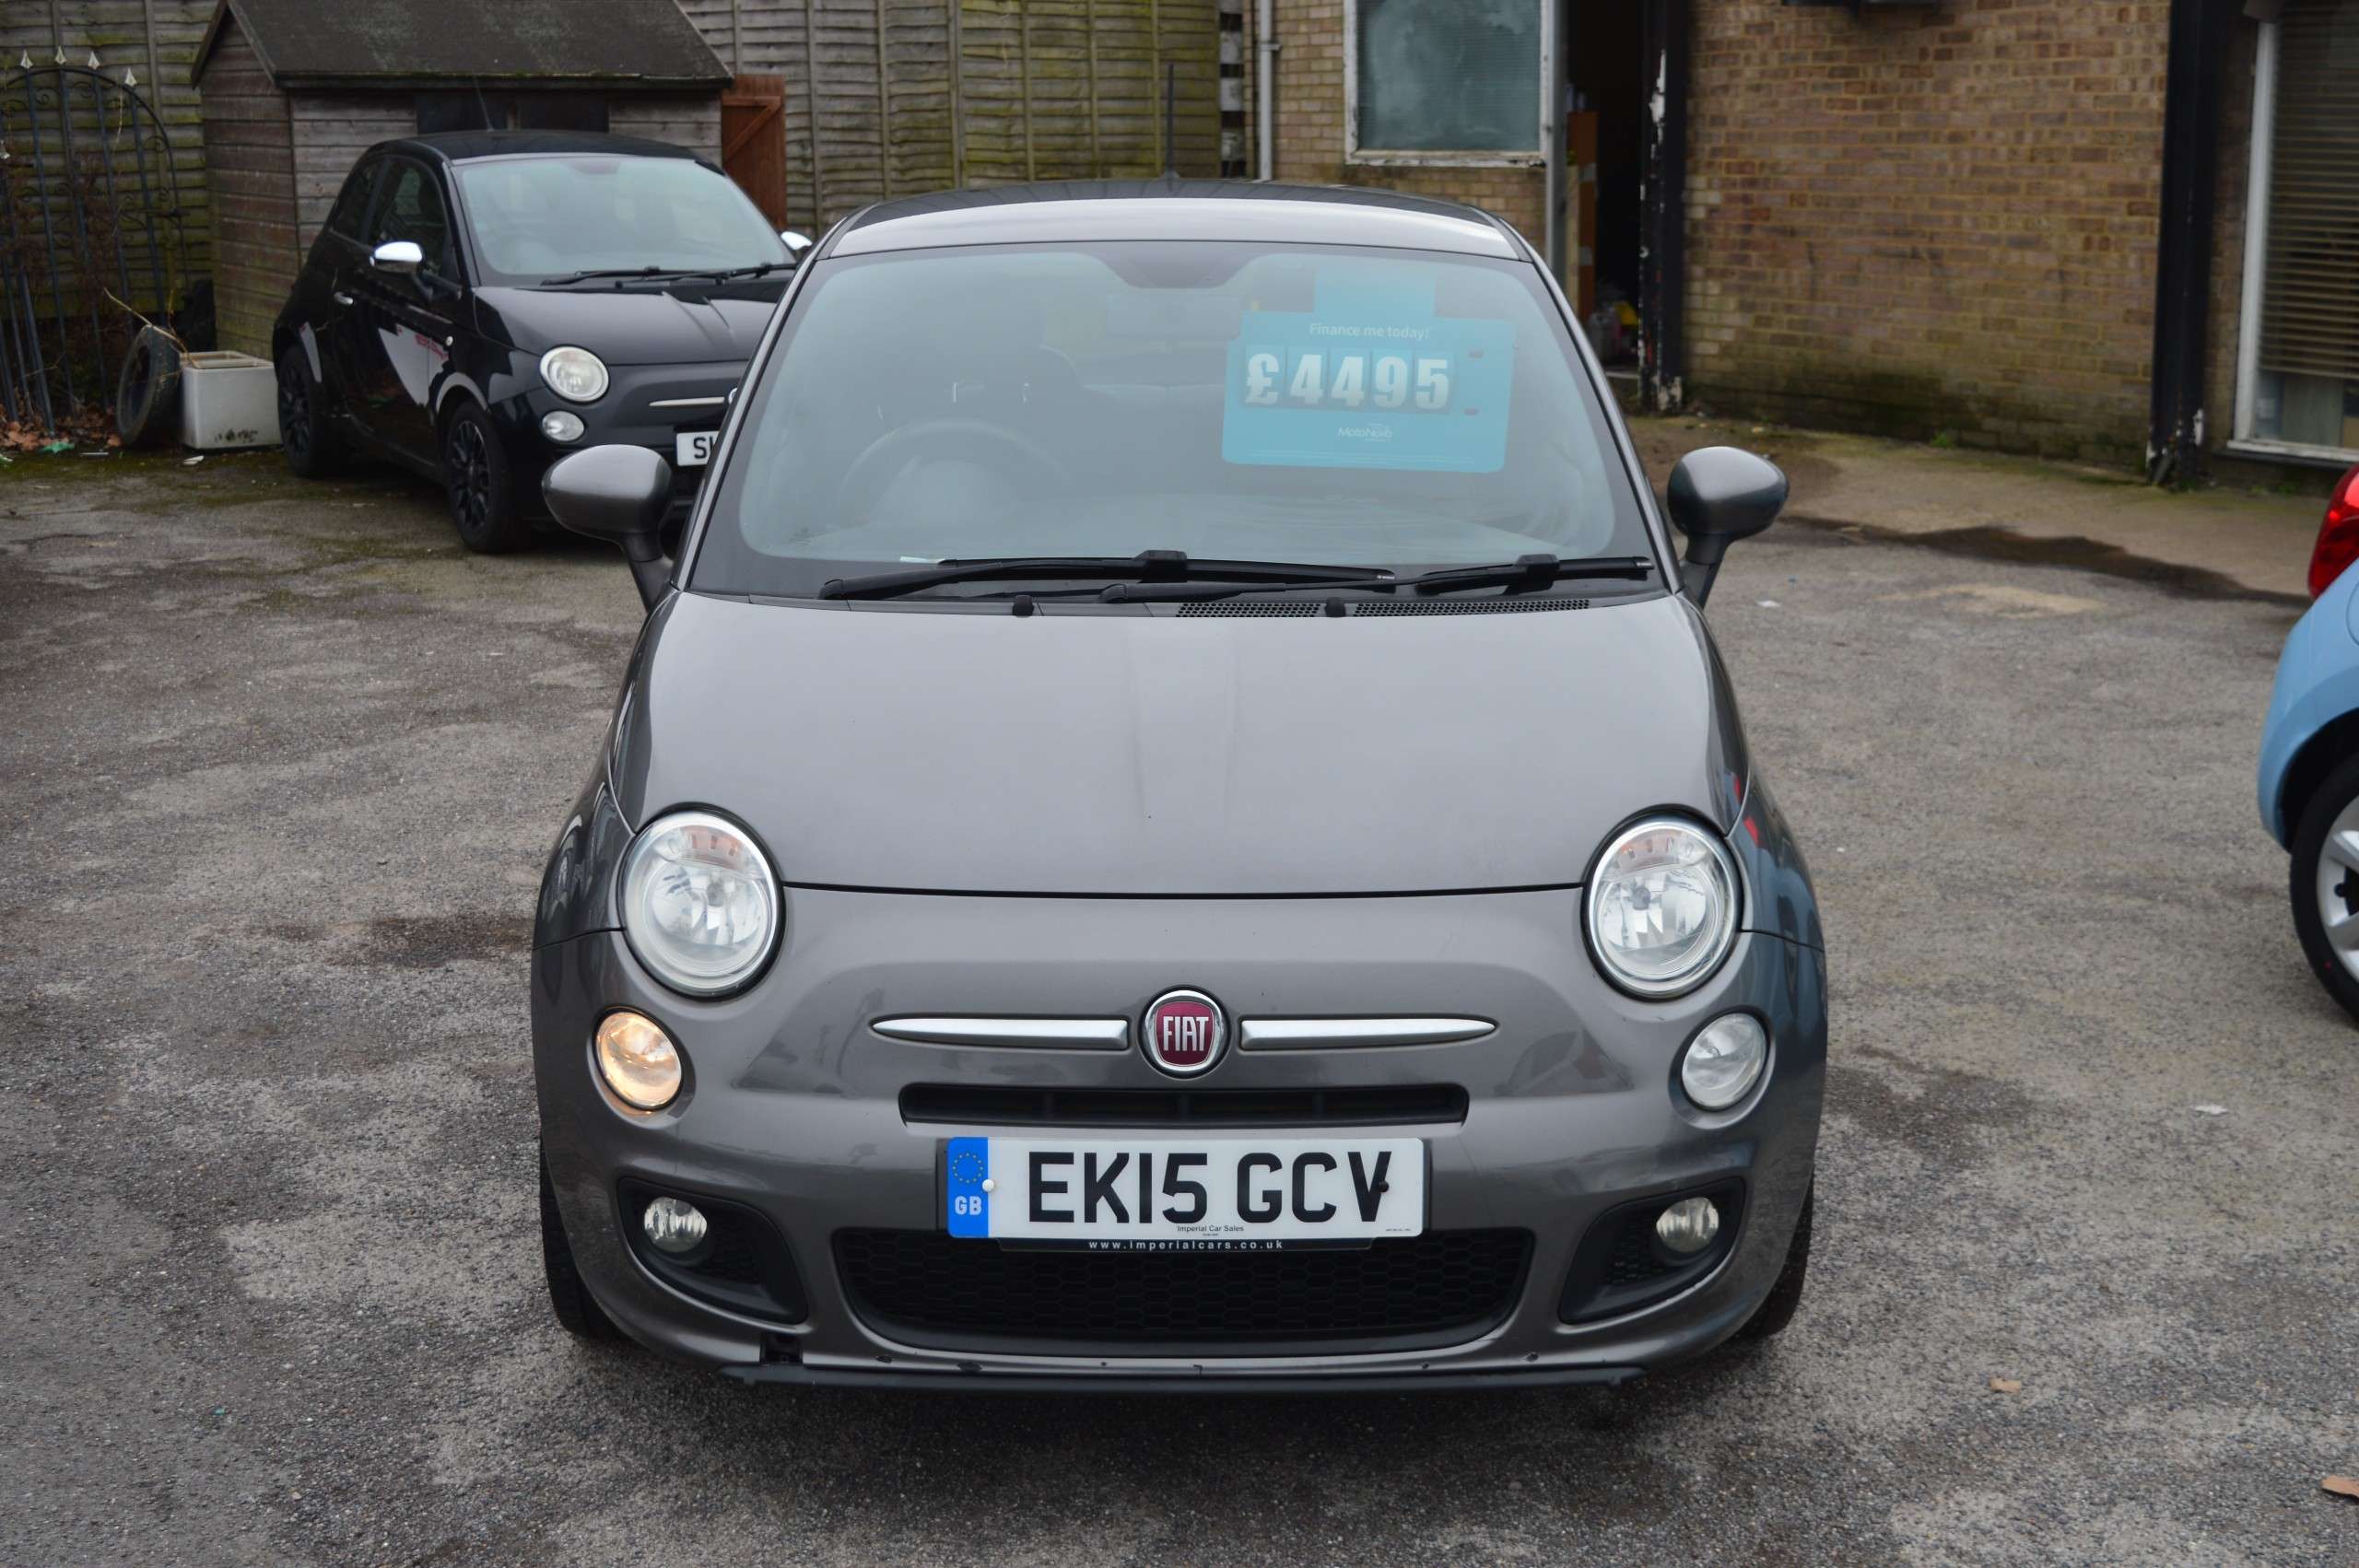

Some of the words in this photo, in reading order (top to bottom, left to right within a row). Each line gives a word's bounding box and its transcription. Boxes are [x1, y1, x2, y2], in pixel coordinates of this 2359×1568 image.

[1309, 322, 1362, 338] Finance
[1364, 326, 1385, 338] me
[1387, 325, 1430, 341] today!
[1246, 353, 1449, 409] £4495
[1162, 1015, 1210, 1052] FIAT
[1029, 1152, 1208, 1223] EK15
[1237, 1152, 1392, 1223] GCV
[954, 1195, 983, 1217] GB
[1177, 1224, 1207, 1233] Imperial
[1087, 1239, 1284, 1252] www.imperialcars.co.uk
